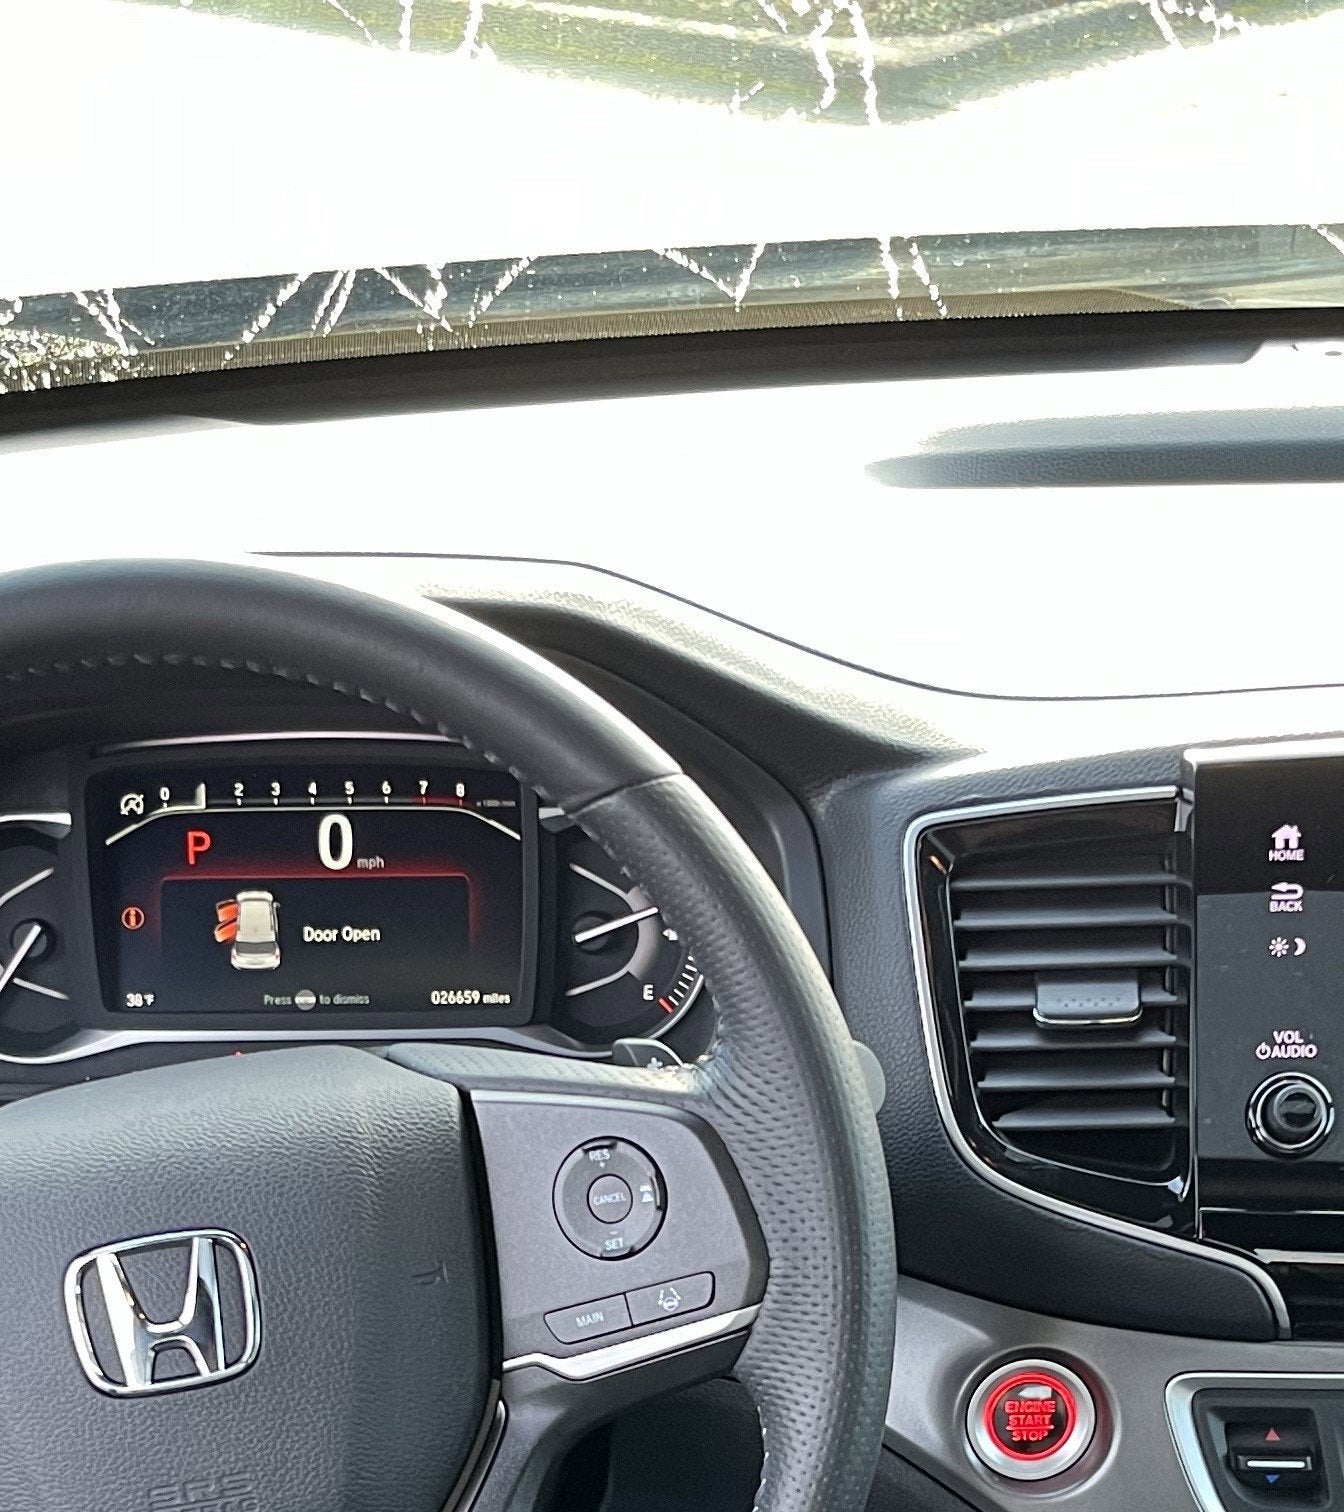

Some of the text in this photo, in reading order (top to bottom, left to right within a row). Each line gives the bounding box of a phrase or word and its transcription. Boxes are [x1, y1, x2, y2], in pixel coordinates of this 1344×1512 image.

[234, 783, 244, 798] 2
[271, 782, 281, 796] 3
[308, 781, 318, 796] 4
[344, 781, 355, 796] 5
[381, 780, 392, 796] 6
[419, 780, 429, 795] 7
[185, 829, 212, 866] P
[317, 813, 355, 871] 0
[1267, 849, 1306, 862] HOME
[356, 856, 386, 872] mph
[1268, 899, 1304, 914] BACK
[303, 926, 382, 946] Door Open
[318, 993, 332, 1005] to
[332, 993, 371, 1005] dismiss
[430, 989, 512, 1006] 026659 miles
[642, 983, 655, 1001] E
[263, 994, 294, 1006] Press
[1272, 1029, 1305, 1045] VOL
[1270, 1043, 1319, 1060] AUDIO
[587, 1148, 612, 1162] RES
[592, 1192, 628, 1206] CANCEL
[604, 1236, 625, 1251] SET
[574, 1311, 605, 1329] MAIN
[1004, 1400, 1057, 1414] ENGINE
[1007, 1414, 1053, 1427] START
[1010, 1429, 1050, 1442] STOP
